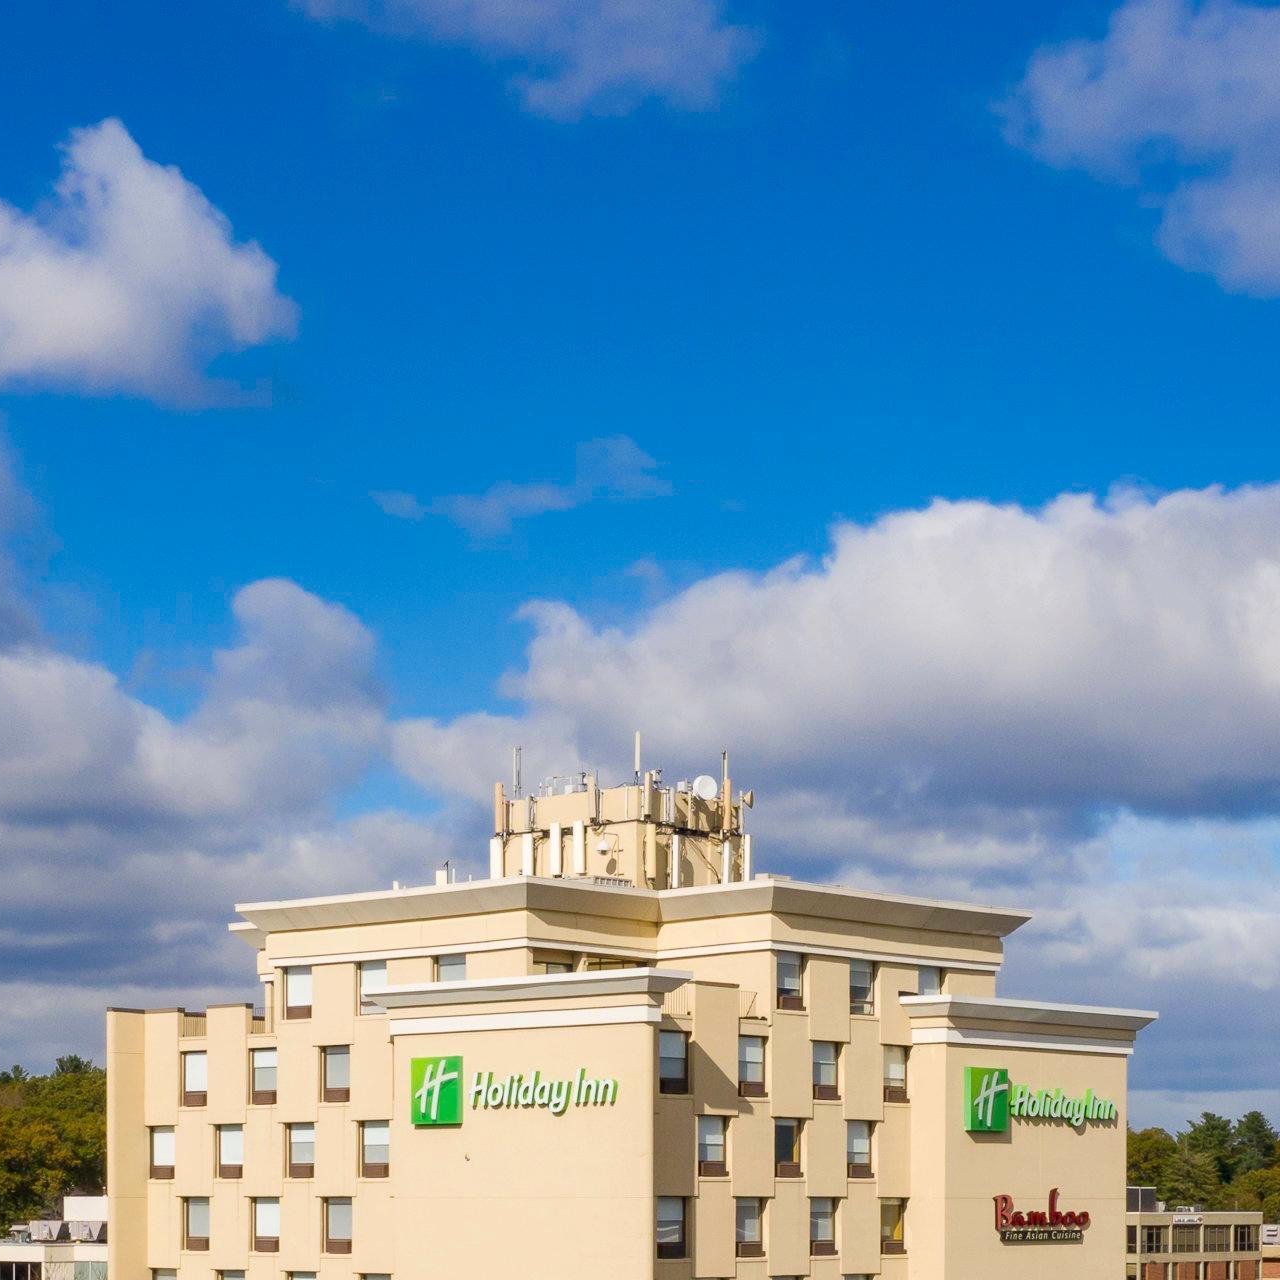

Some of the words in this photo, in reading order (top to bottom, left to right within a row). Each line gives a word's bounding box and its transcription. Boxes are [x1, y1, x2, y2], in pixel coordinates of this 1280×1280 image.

[414, 1059, 459, 1121] H
[469, 1070, 571, 1115] Holiday
[573, 1067, 618, 1106] Inn
[973, 1071, 1009, 1127] H
[1010, 1085, 1084, 1126] Holiday
[1085, 1087, 1116, 1120] Inn
[992, 1187, 1090, 1231] Bamboo
[1005, 1231, 1023, 1240] Fine
[1025, 1231, 1048, 1240] Asian
[1051, 1230, 1081, 1240] Cuisine
